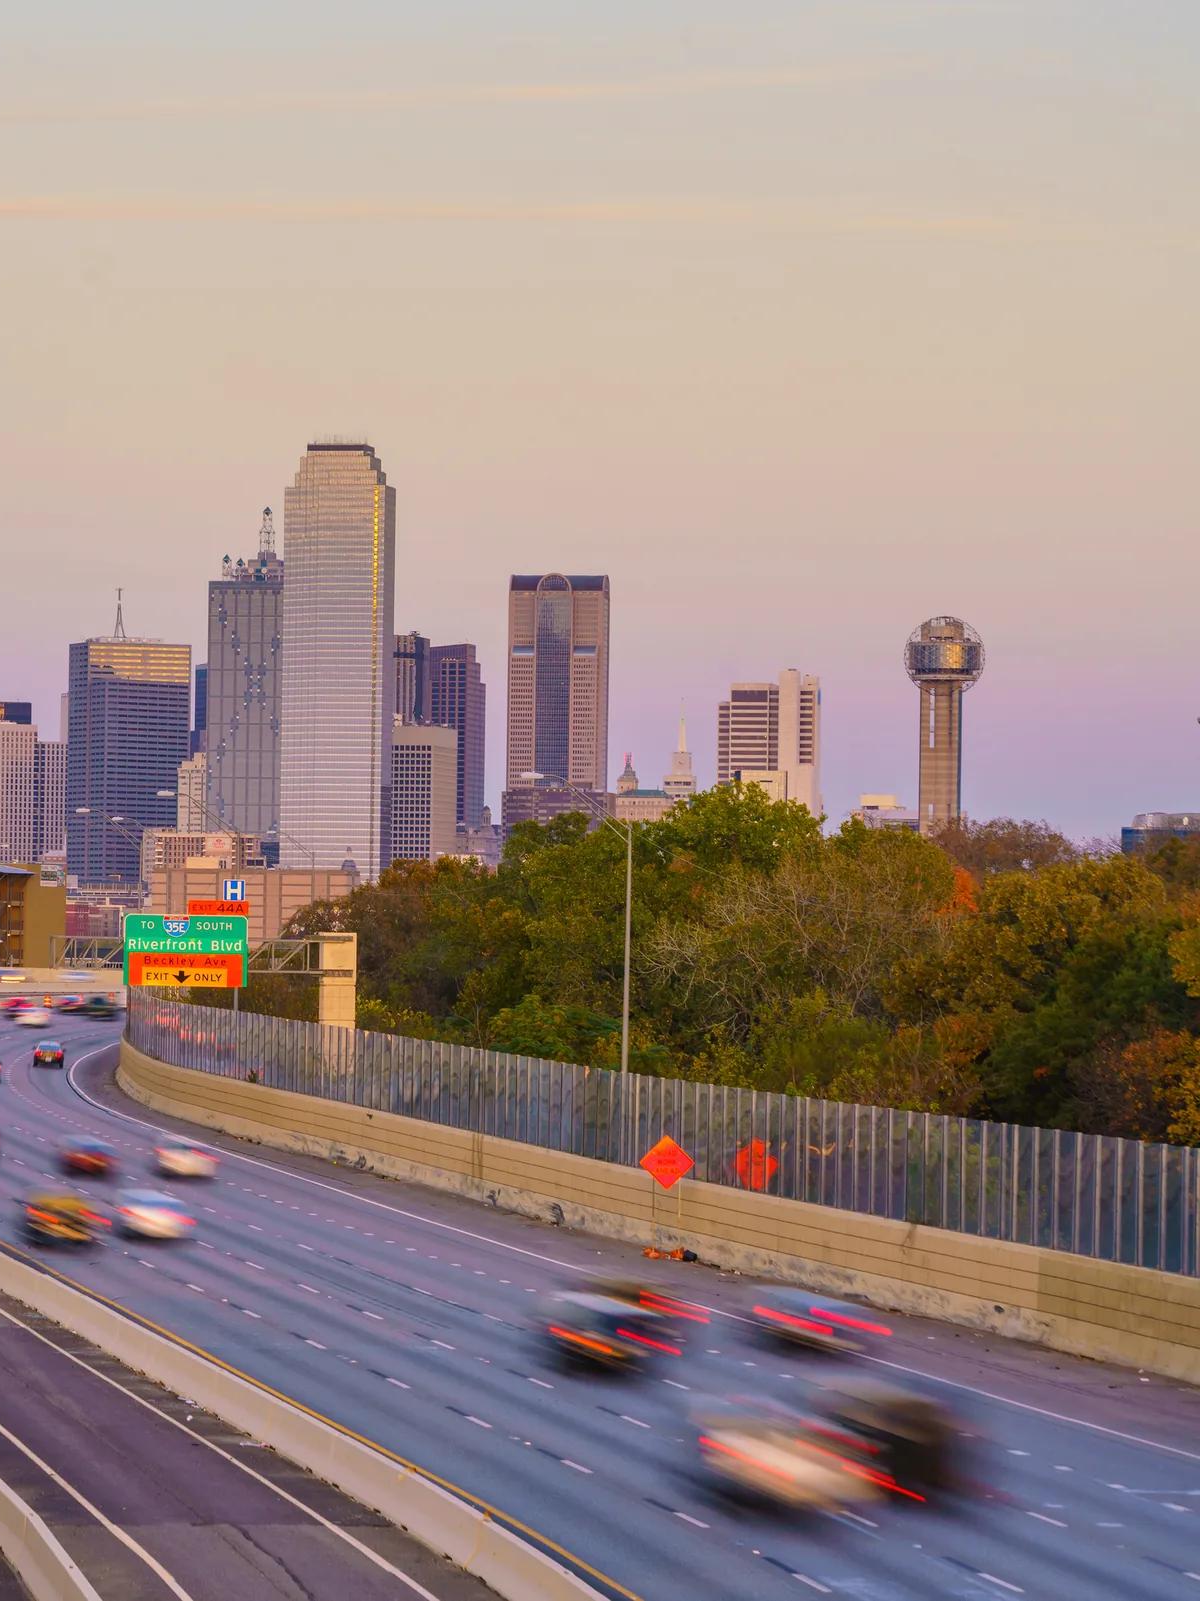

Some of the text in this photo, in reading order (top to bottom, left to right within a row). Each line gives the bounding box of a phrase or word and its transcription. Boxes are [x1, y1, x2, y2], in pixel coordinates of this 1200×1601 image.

[191, 903, 244, 913] EXIT 44A
[140, 920, 233, 933] TO 35E SOUTH
[128, 938, 242, 951] Riverfront Blvd
[144, 956, 227, 967] Beckley Ave
[146, 972, 222, 982] EXIT ONLY
